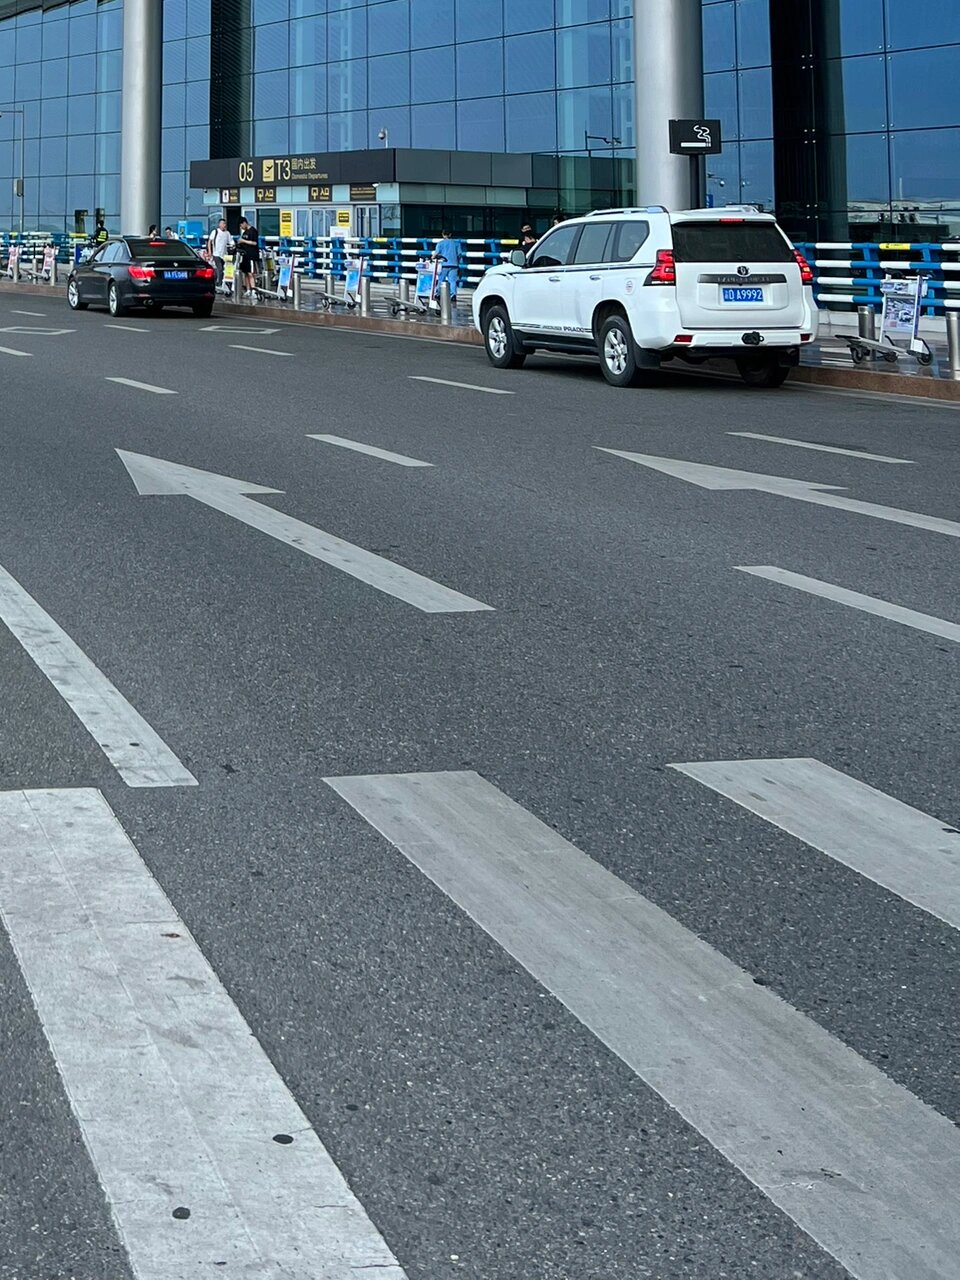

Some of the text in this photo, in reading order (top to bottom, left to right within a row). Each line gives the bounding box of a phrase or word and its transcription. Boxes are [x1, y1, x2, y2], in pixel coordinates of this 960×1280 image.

[238, 161, 254, 182] 05
[275, 159, 291, 180] T3
[291, 157, 317, 170] 国内出发
